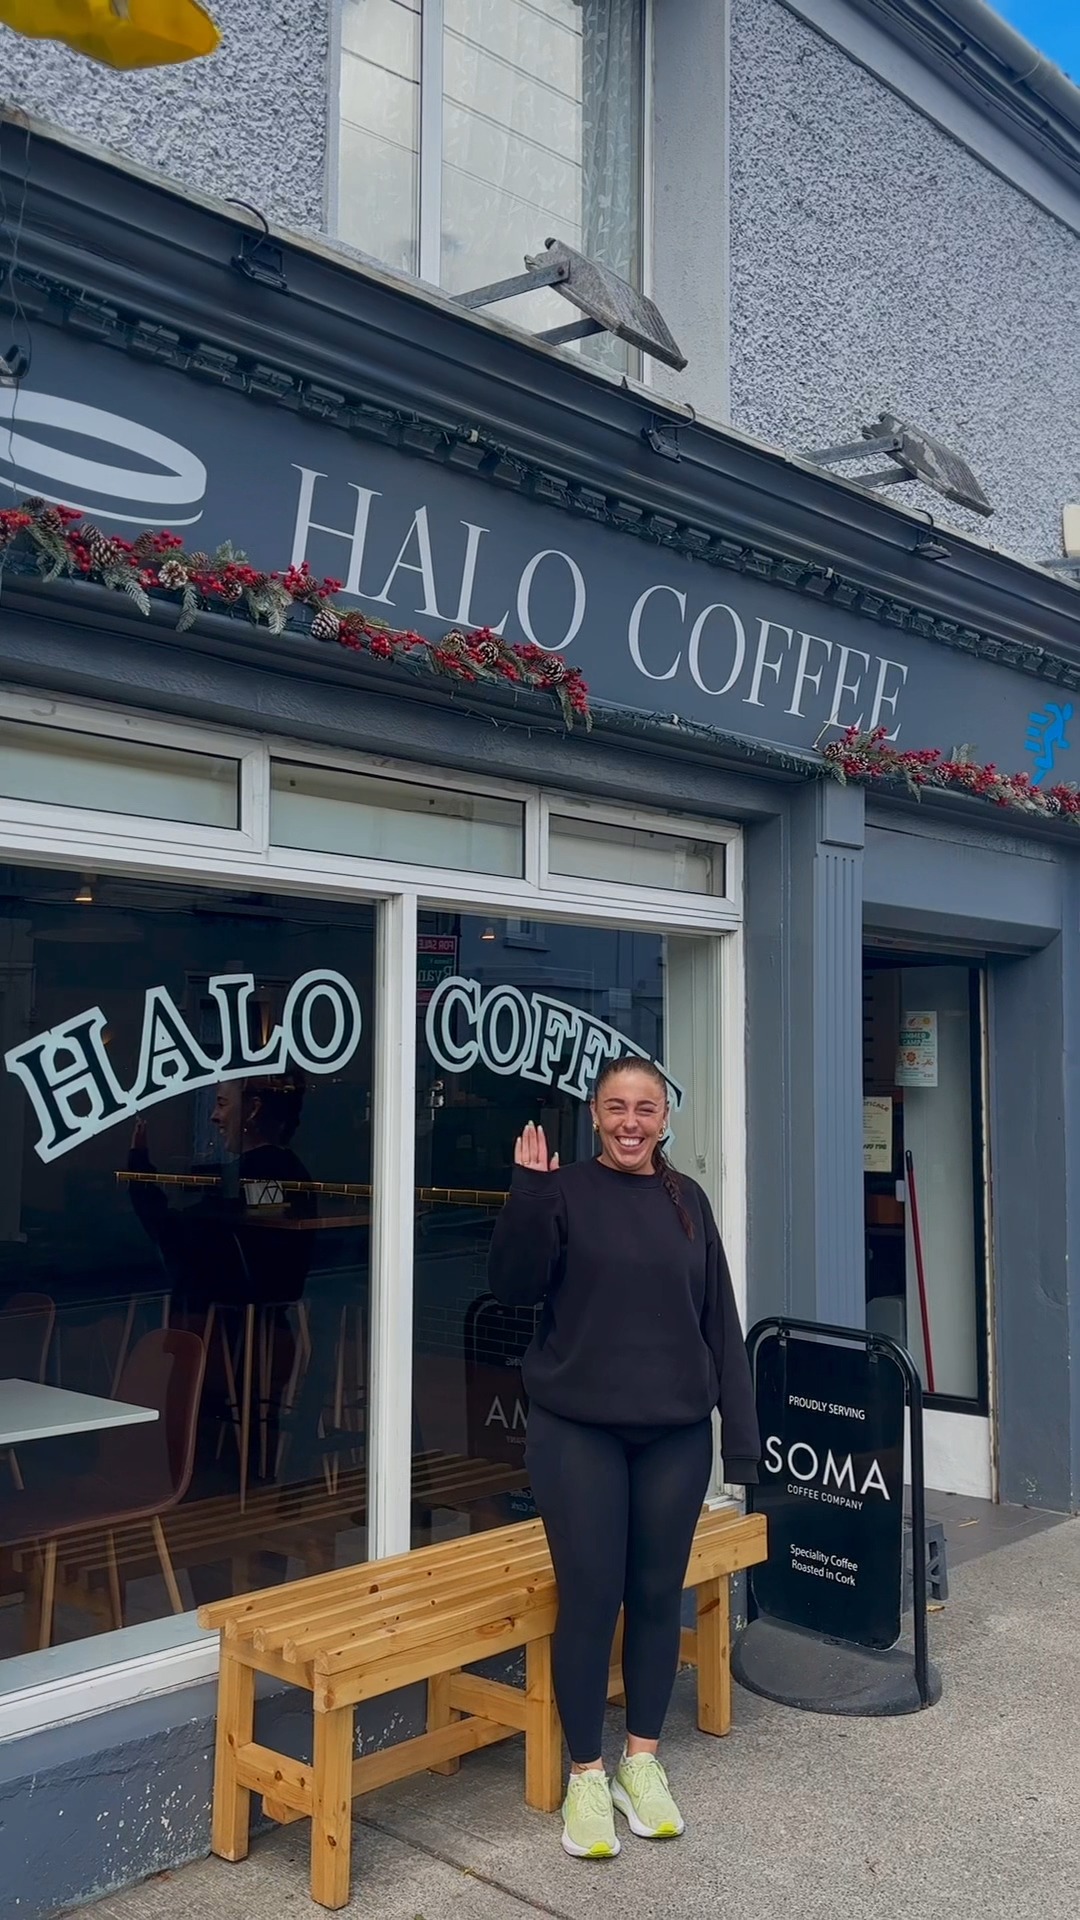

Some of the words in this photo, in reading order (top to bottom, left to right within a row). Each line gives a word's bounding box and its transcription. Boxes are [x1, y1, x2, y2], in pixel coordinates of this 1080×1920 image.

[280, 463, 587, 651] HALO
[627, 584, 909, 742] COFFEE
[4, 968, 362, 1164] HALO
[788, 1395, 828, 1412] PROUDLY
[828, 1403, 866, 1420] SERVING
[764, 1435, 891, 1501] SOMA
[787, 1483, 820, 1500] COFFEE
[821, 1492, 864, 1511] COMPANY
[789, 1543, 830, 1566] Speciality
[830, 1555, 859, 1572] Coffee
[791, 1558, 825, 1577] Roasted
[825, 1568, 834, 1580] in
[835, 1571, 856, 1587] Cork
